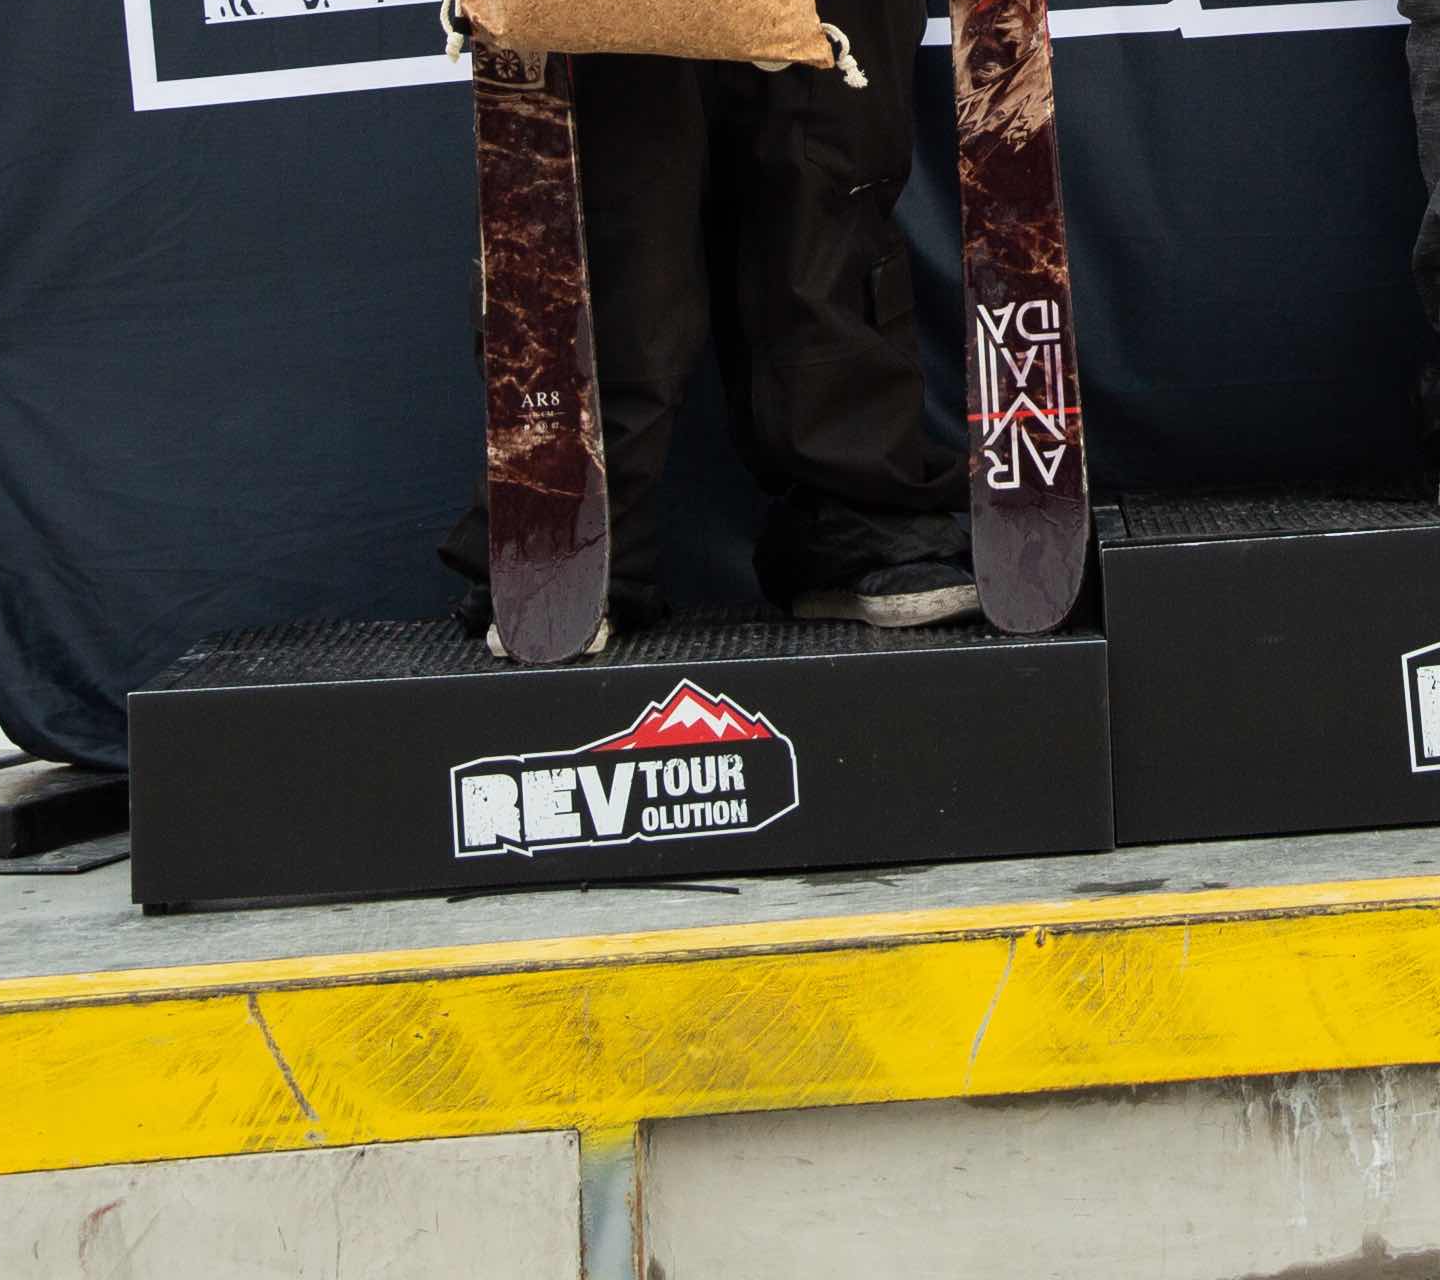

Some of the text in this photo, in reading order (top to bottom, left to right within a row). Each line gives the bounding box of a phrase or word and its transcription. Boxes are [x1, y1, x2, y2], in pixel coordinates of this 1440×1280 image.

[521, 391, 560, 408] AR8
[461, 754, 746, 847] REV TOUR
[641, 799, 749, 833] OLUTION
